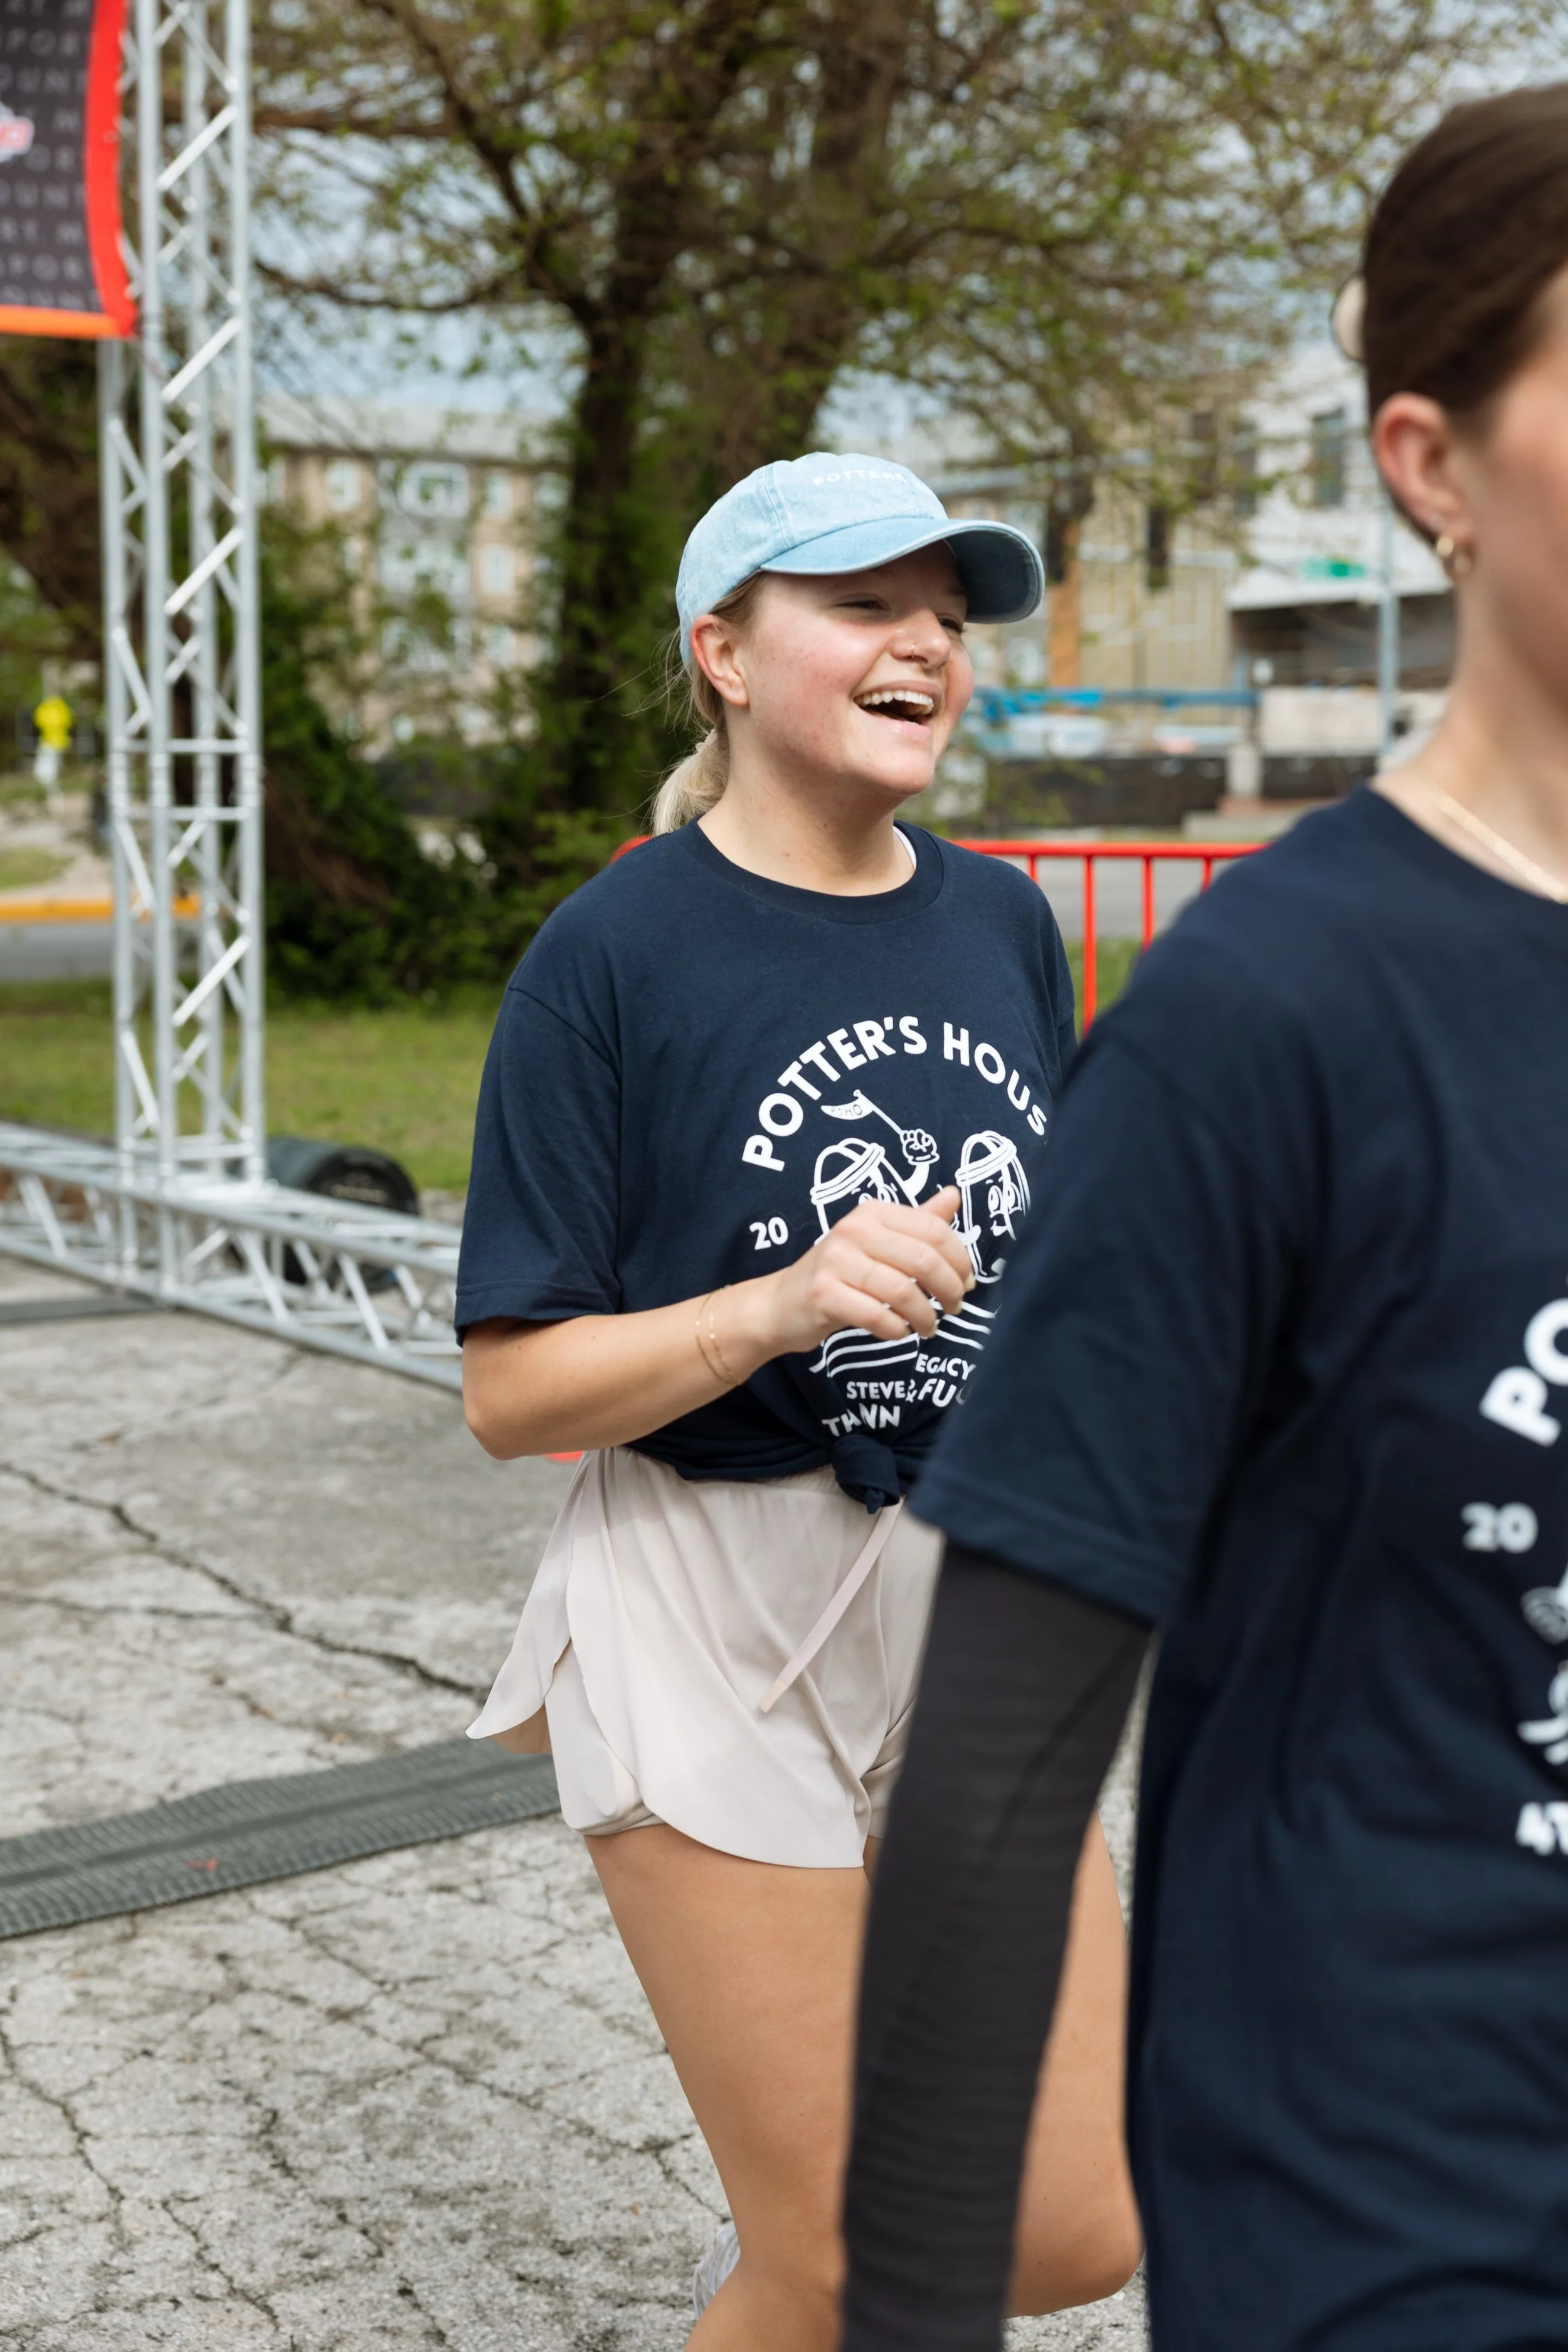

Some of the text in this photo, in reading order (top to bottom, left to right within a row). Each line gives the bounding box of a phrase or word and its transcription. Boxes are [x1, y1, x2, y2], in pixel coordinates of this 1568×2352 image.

[741, 1015, 1048, 1172] POTTER'S HOUS
[749, 1217, 789, 1250] 20
[847, 1380, 906, 1399] STEVE
[917, 1378, 972, 1408] FU
[1461, 1501, 1539, 1554] 20
